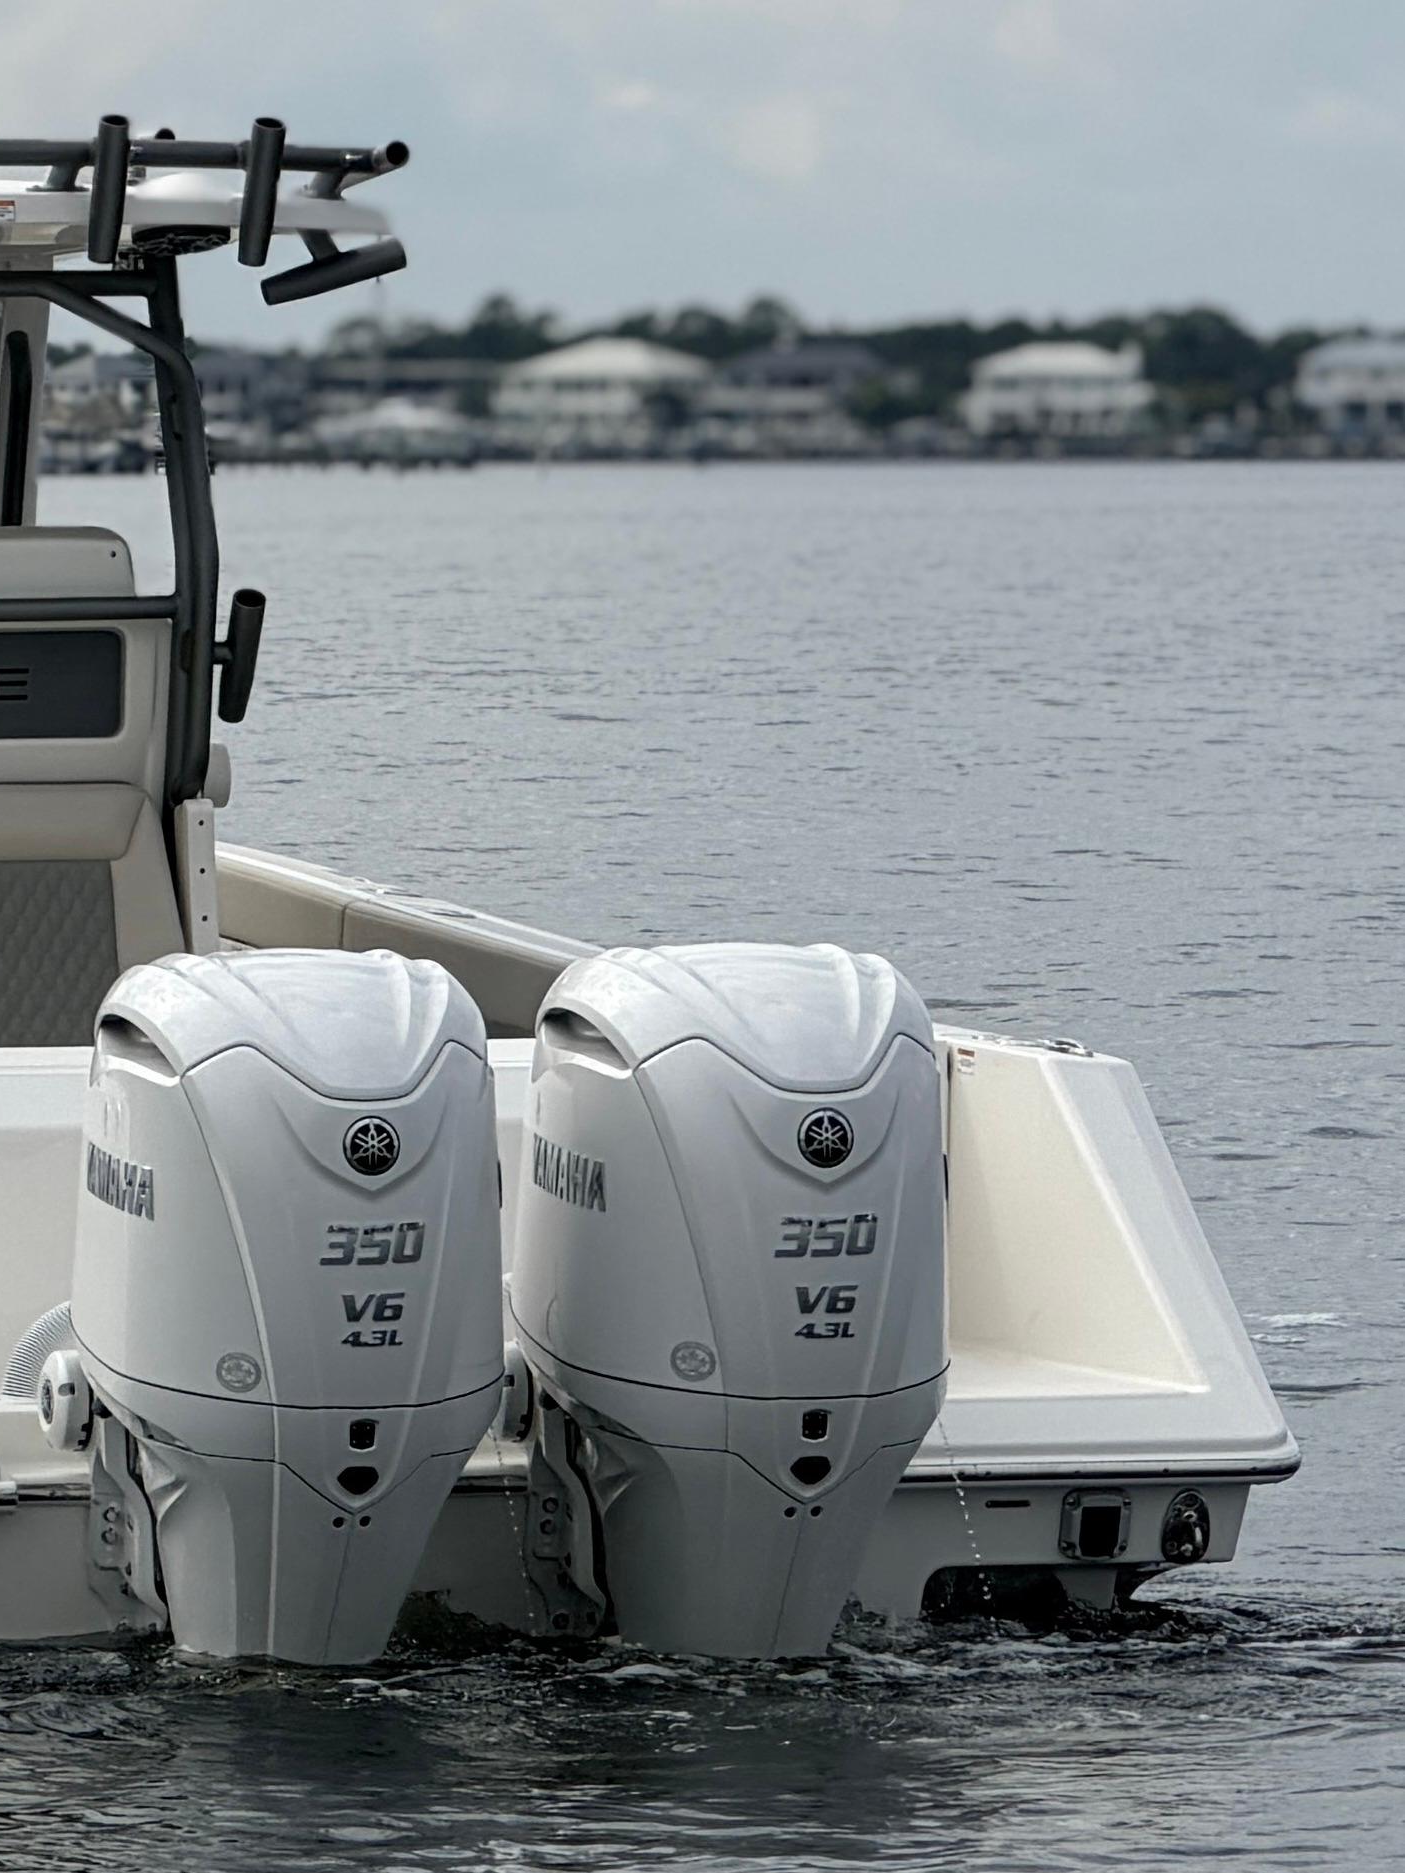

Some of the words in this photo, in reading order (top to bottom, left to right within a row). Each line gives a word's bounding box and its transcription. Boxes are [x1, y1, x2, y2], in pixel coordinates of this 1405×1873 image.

[87, 1141, 154, 1221] YAMAHA
[534, 1132, 606, 1212] YAMAHA
[319, 1222, 425, 1266] 350
[774, 1213, 878, 1258] 350
[342, 1292, 406, 1323] V6
[795, 1285, 859, 1314] V6
